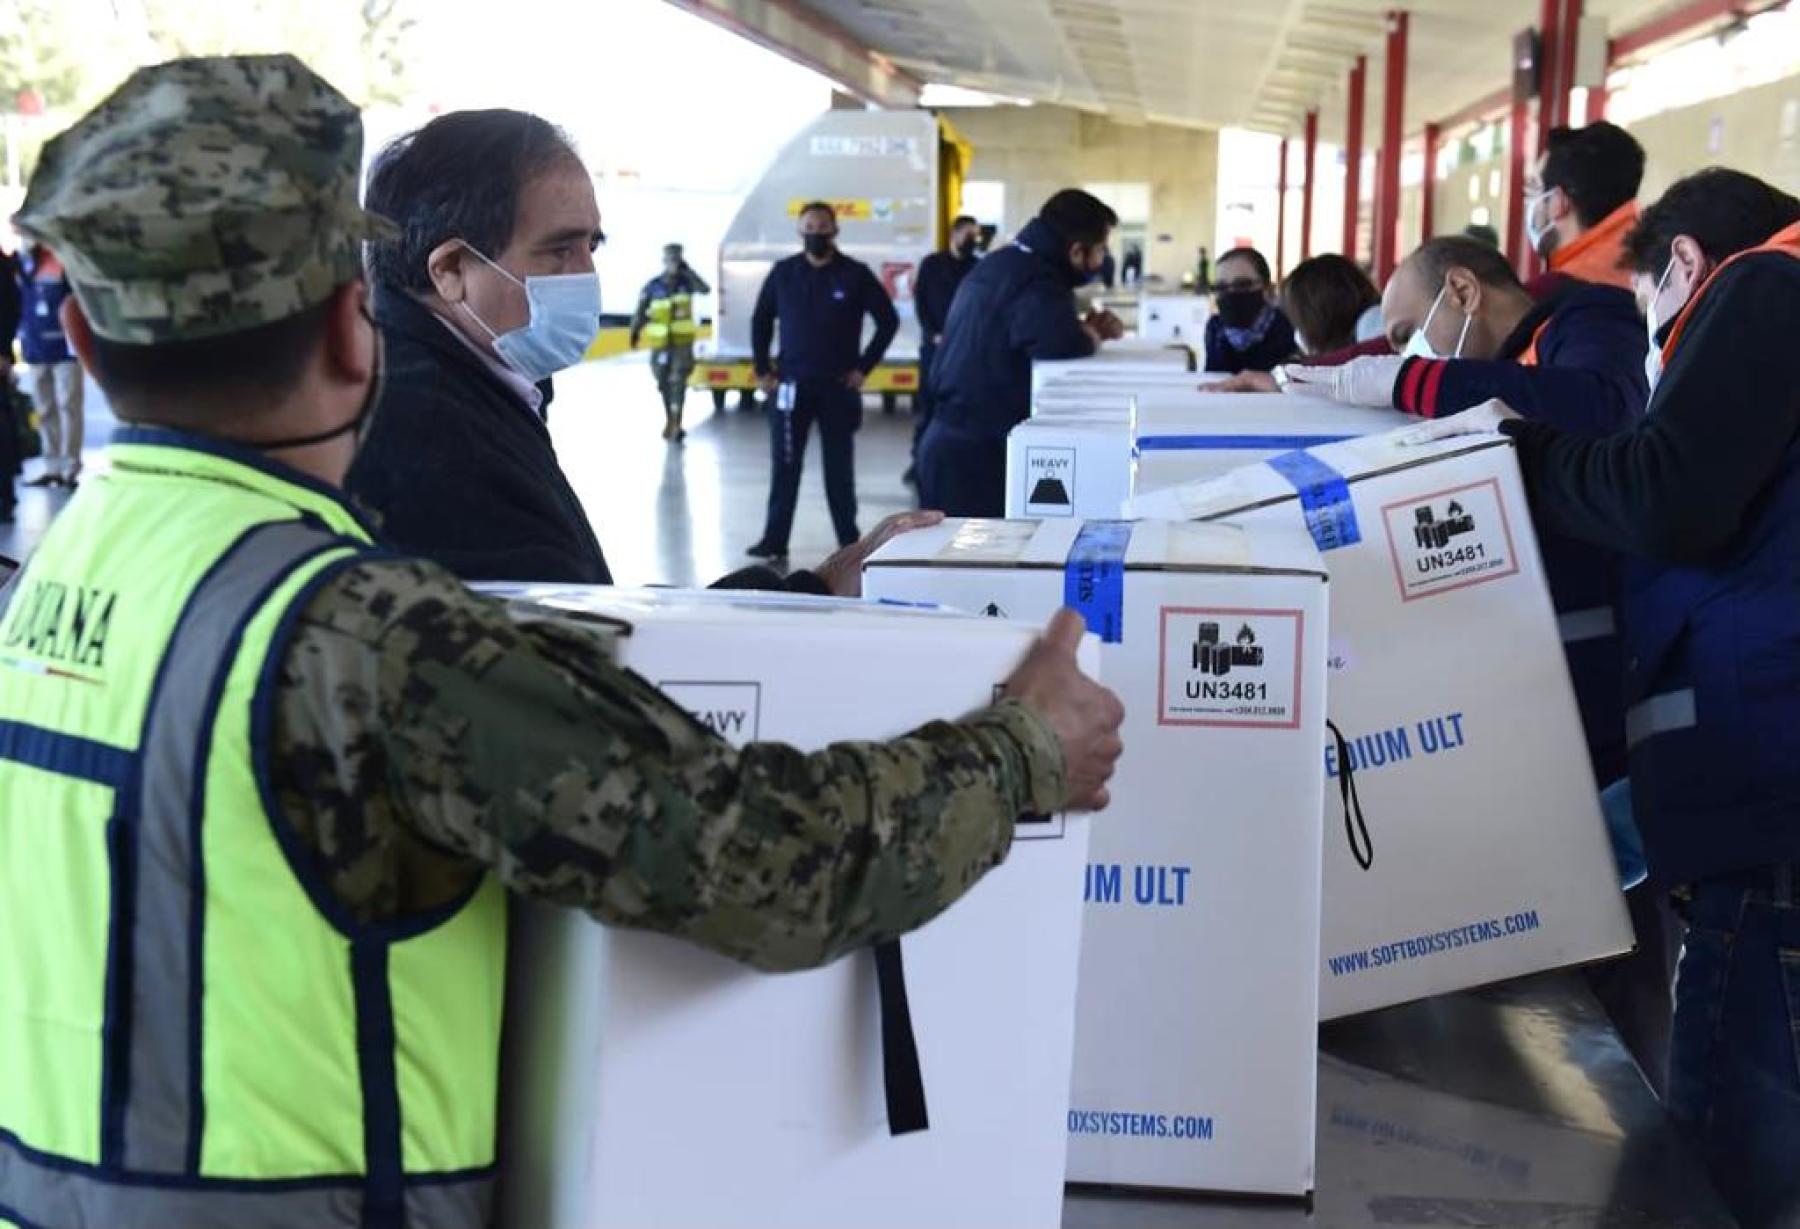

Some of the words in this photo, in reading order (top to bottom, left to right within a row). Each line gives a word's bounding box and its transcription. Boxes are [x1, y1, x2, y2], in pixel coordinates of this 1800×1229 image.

[1031, 457, 1070, 469] HEAVY
[1416, 542, 1486, 573] UN3481
[1185, 680, 1267, 700] UN3481
[1416, 711, 1465, 754] ULT
[1135, 866, 1191, 905] ULT
[1328, 909, 1540, 977] WWW.SOFTBOXSYSTEMS.COM
